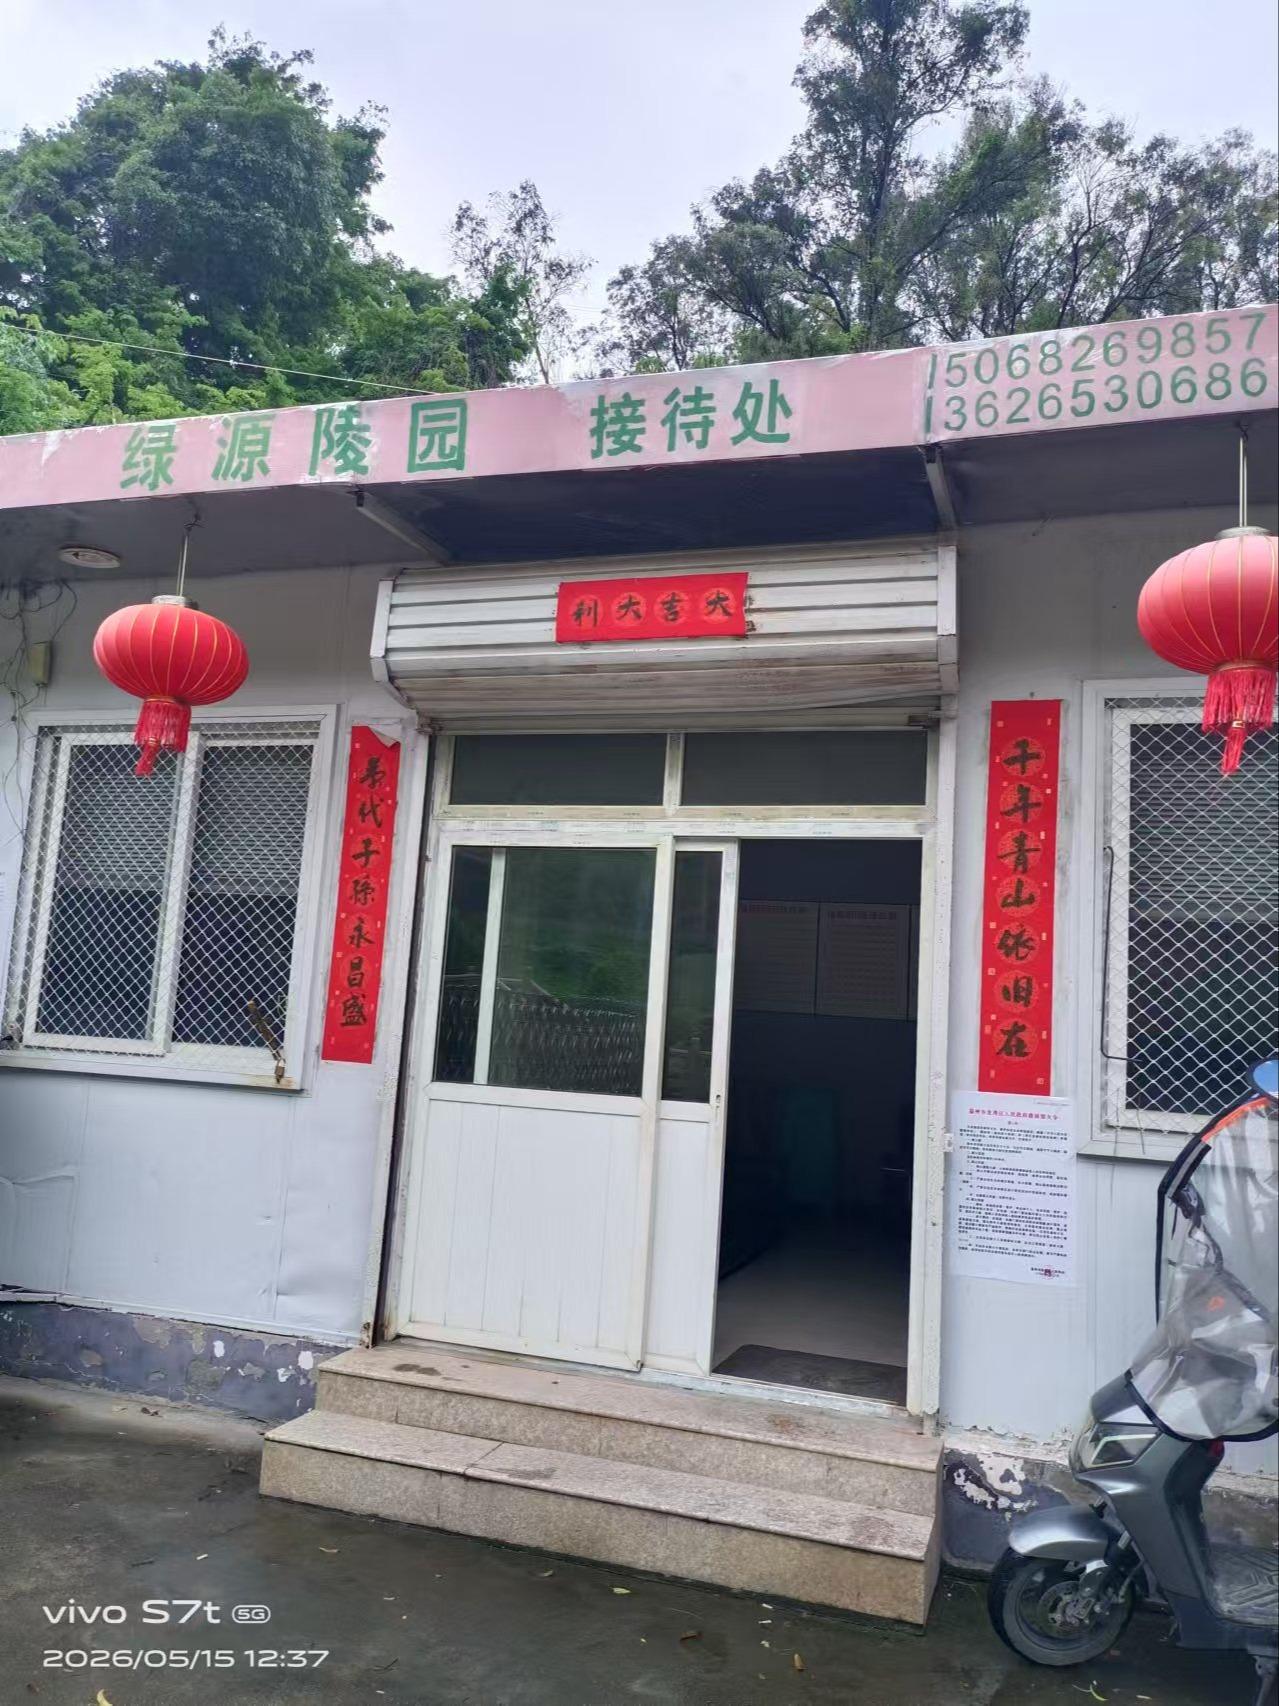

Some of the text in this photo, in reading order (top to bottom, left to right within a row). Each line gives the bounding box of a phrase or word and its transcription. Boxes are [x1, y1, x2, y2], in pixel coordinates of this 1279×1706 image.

[927, 312, 1267, 389] 15068269857
[923, 357, 1268, 434] 13626530686
[119, 379, 793, 492] 绿源陵园 接待处
